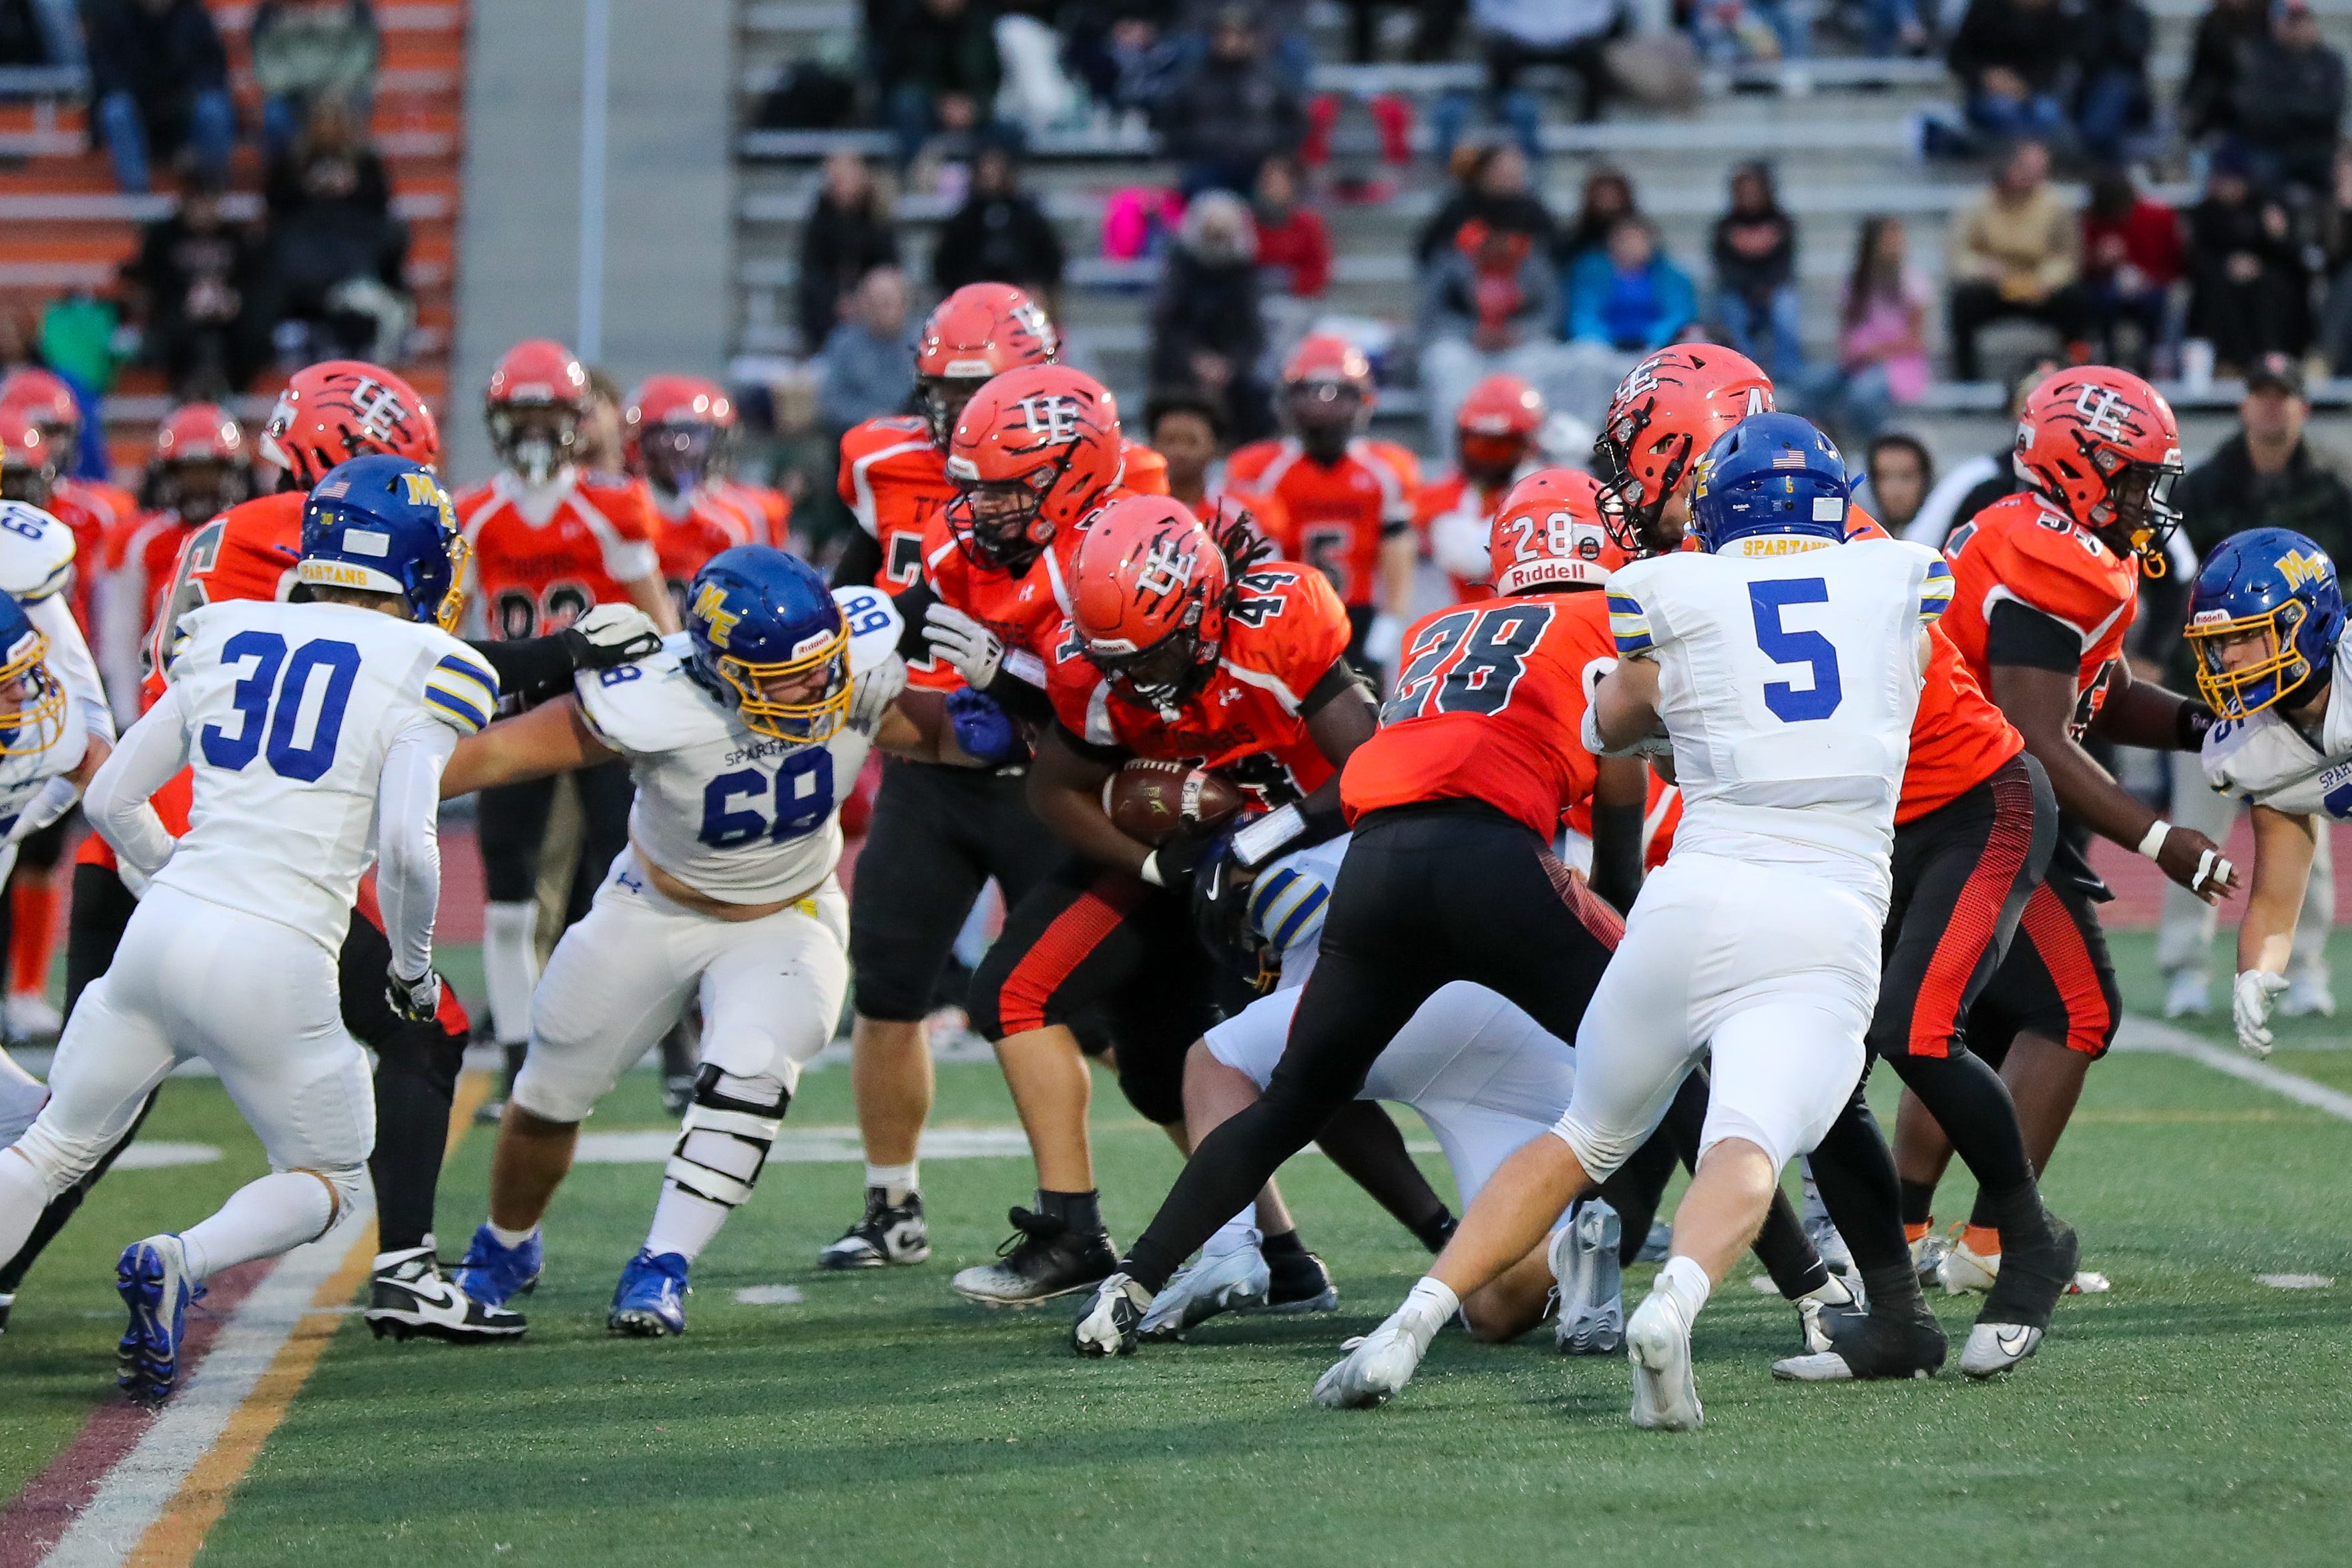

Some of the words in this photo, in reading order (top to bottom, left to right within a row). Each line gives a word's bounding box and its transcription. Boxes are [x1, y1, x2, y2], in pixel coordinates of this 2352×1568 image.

[1785, 481, 1795, 493] 5
[1511, 512, 1574, 563] 28
[1228, 571, 1301, 629] 44
[1511, 563, 1586, 588] Riddell
[2196, 613, 2223, 623] Riddell
[1378, 601, 1557, 730] 28
[1748, 577, 1843, 723] 5
[201, 631, 361, 782] 30
[698, 746, 834, 850] 68
